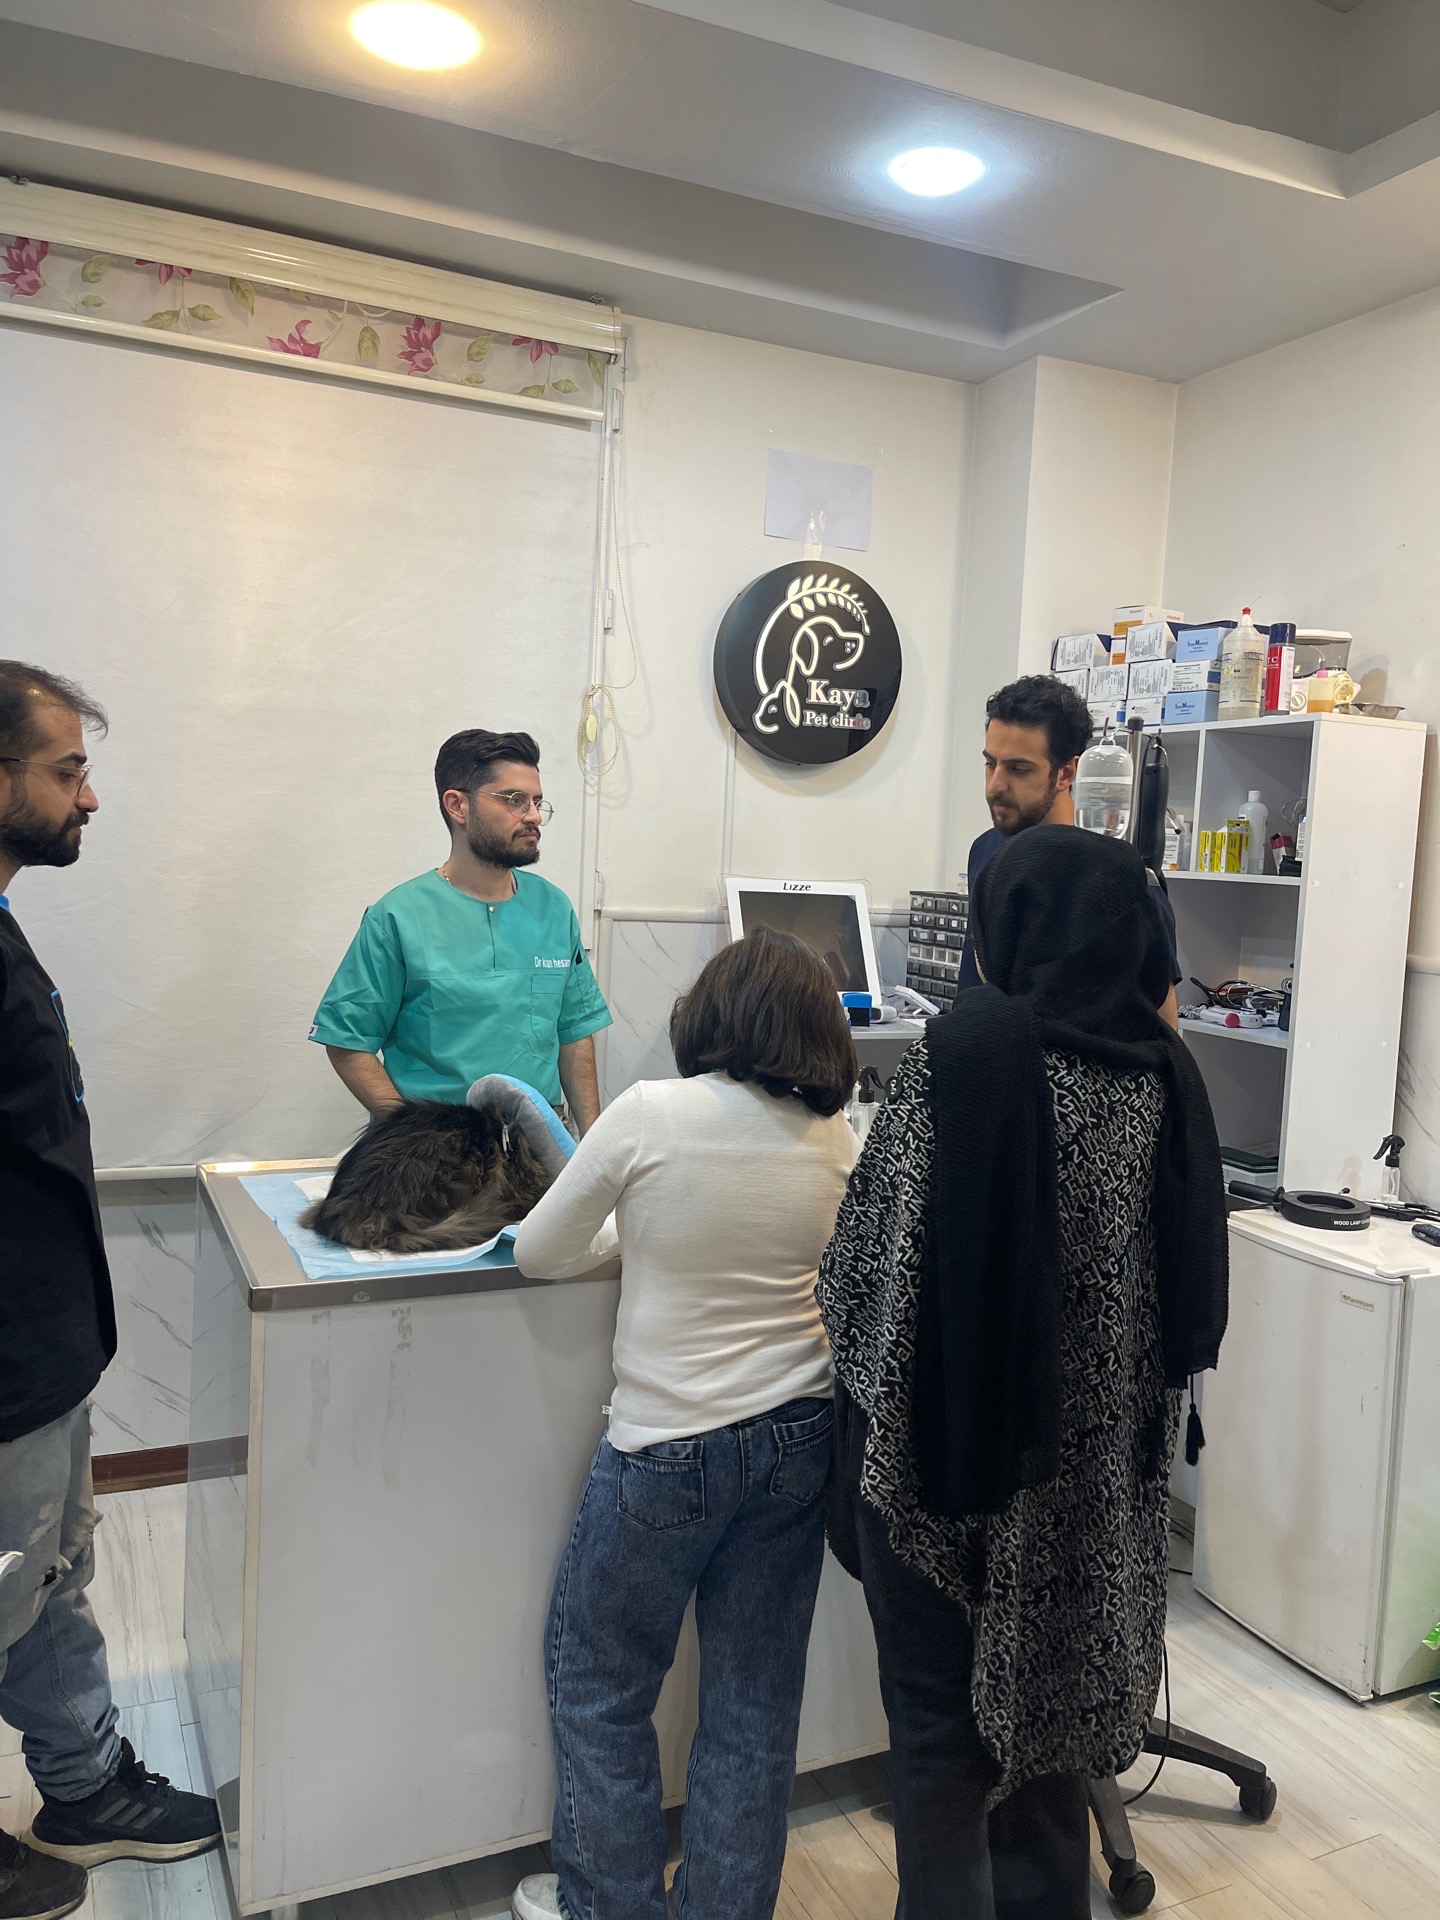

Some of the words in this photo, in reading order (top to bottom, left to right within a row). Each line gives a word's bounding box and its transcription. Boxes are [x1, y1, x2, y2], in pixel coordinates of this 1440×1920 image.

[808, 679, 870, 711] Kaya
[804, 711, 828, 726] Pet
[831, 713, 871, 729] clinic
[783, 882, 812, 892] Lizze
[534, 956, 542, 968] Dr
[542, 956, 553, 968] kian
[1346, 1295, 1374, 1309] Parmisan
